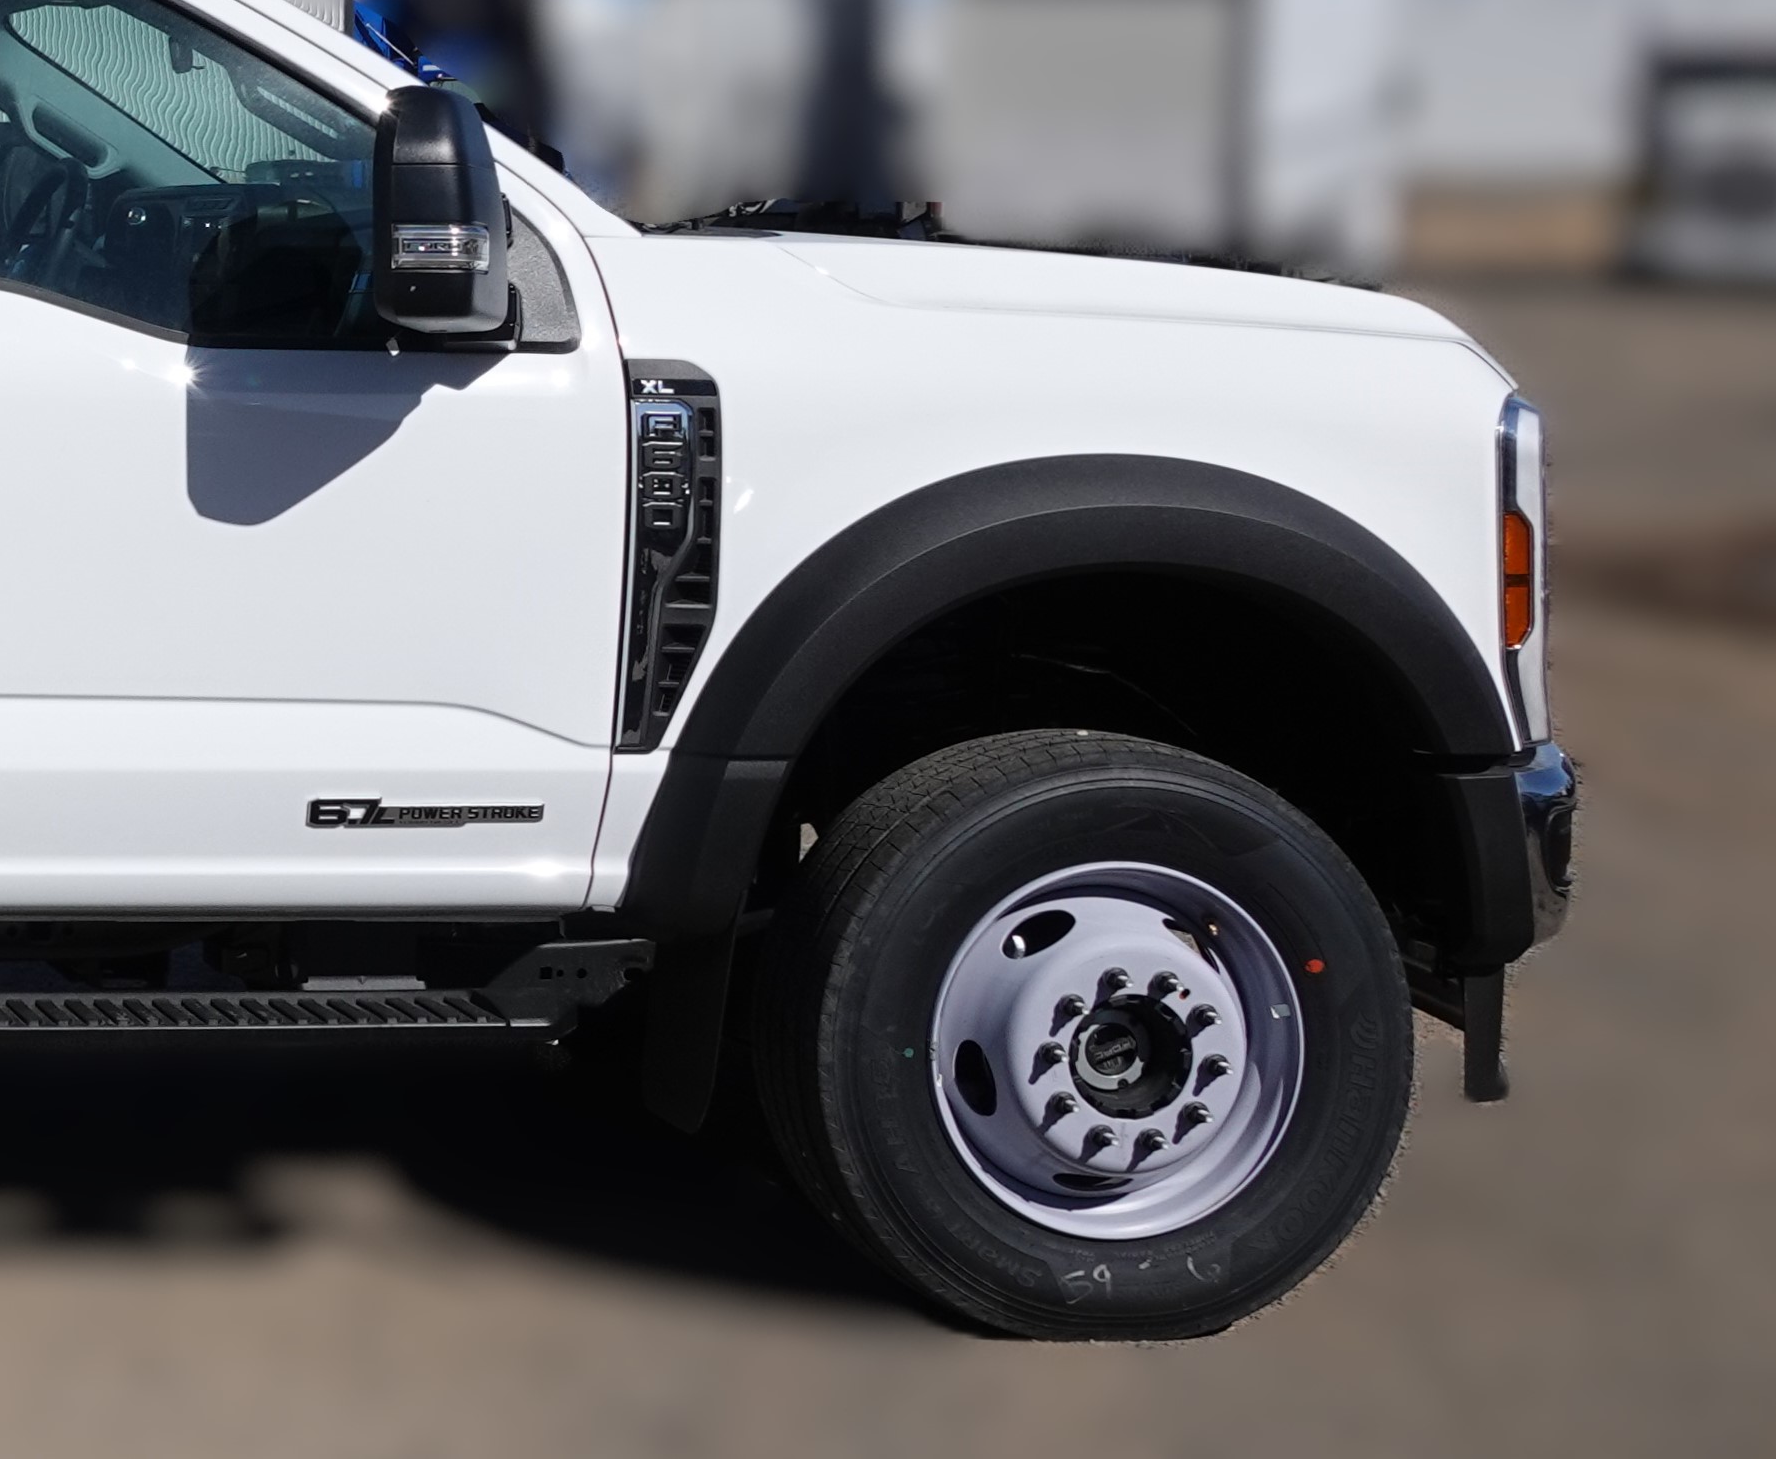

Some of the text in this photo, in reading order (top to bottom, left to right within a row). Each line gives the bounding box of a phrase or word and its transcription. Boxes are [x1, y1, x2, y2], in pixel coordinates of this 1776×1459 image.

[640, 379, 675, 394] XL
[399, 806, 462, 820] POWER
[467, 805, 539, 819] STROKE
